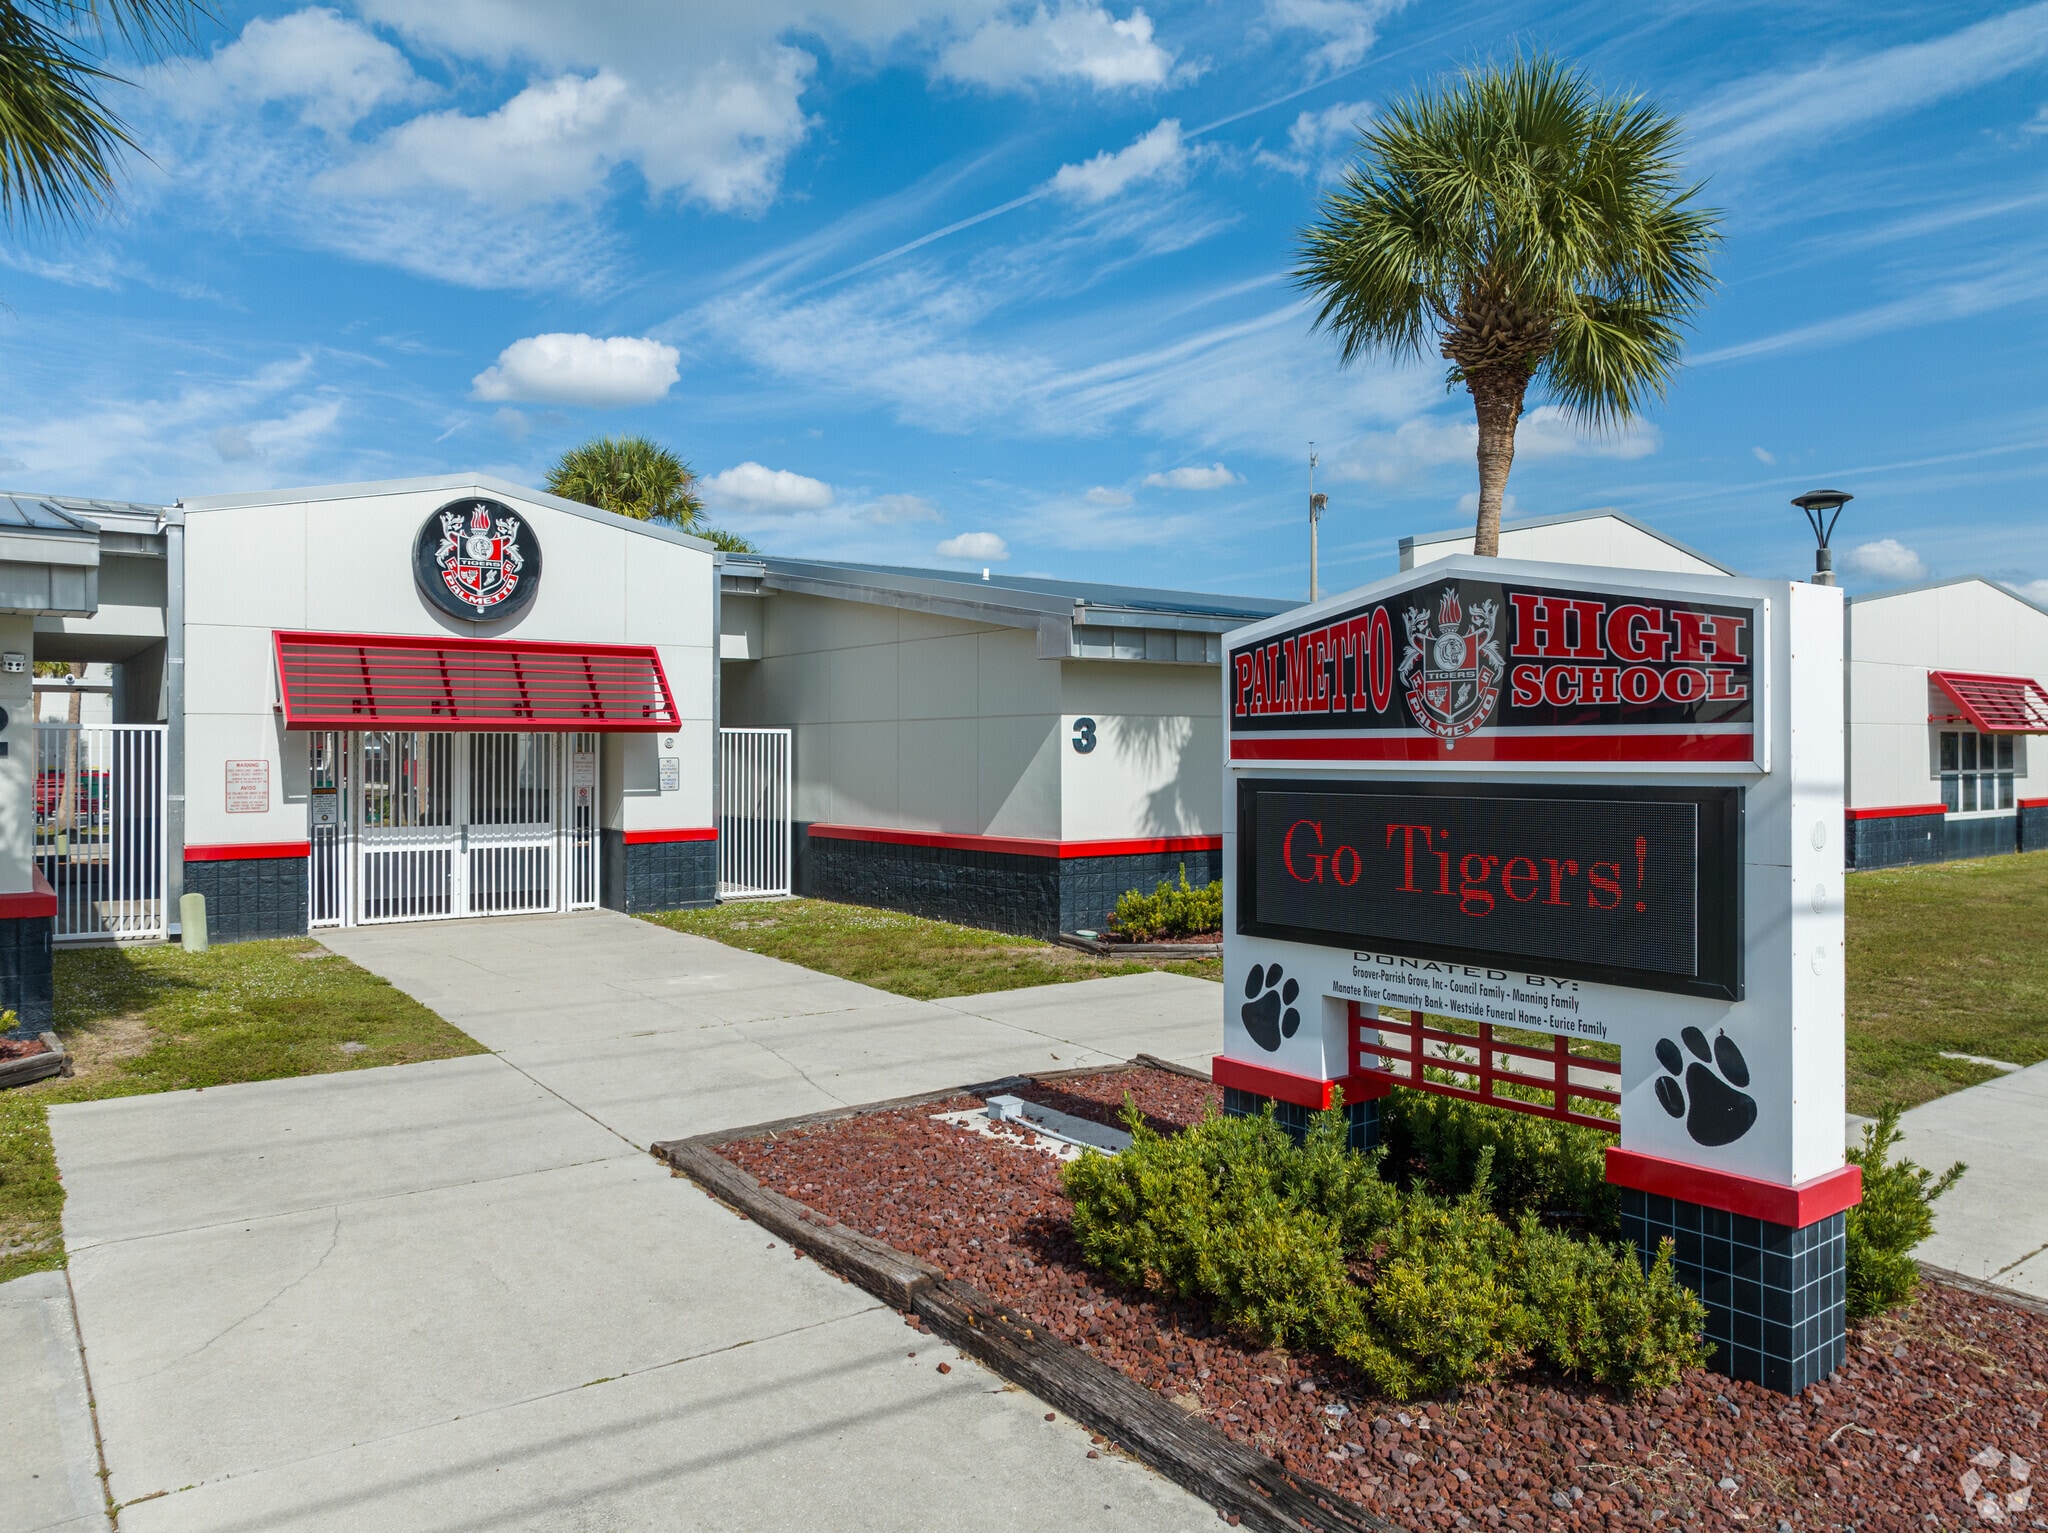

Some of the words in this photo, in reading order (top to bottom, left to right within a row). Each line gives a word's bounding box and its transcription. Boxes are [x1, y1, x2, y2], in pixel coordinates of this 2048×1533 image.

[445, 575, 516, 605] PALMETTO
[1509, 592, 1747, 665] HIGH
[1235, 604, 1393, 717] PALMETTO
[1427, 671, 1476, 680] TIGERS
[1511, 664, 1747, 708] SCHOOL
[1072, 717, 1097, 754] 3
[1410, 694, 1495, 737] PALMETTO
[1283, 819, 1362, 886] Go
[1386, 823, 1647, 917] Tigers!
[1352, 965, 1406, 984] Groover-Parrish
[1408, 973, 1430, 990] Grove,
[1432, 977, 1443, 990] Inc
[1450, 979, 1477, 994] Council
[1479, 984, 1505, 1002] Family
[1512, 989, 1549, 1009] Manning
[1551, 994, 1580, 1013] Family
[1354, 951, 1507, 981] DONATED
[1526, 975, 1579, 991] BY:
[1332, 980, 1362, 996] Manatee
[1363, 986, 1381, 999] River
[1382, 989, 1422, 1009] Community
[1425, 996, 1444, 1009] Bank
[1450, 999, 1484, 1016] Westside
[1486, 1005, 1516, 1021] Funeral
[1518, 1010, 1542, 1025] Home
[1550, 1015, 1575, 1031] Eurice
[1578, 1019, 1608, 1039] Family
